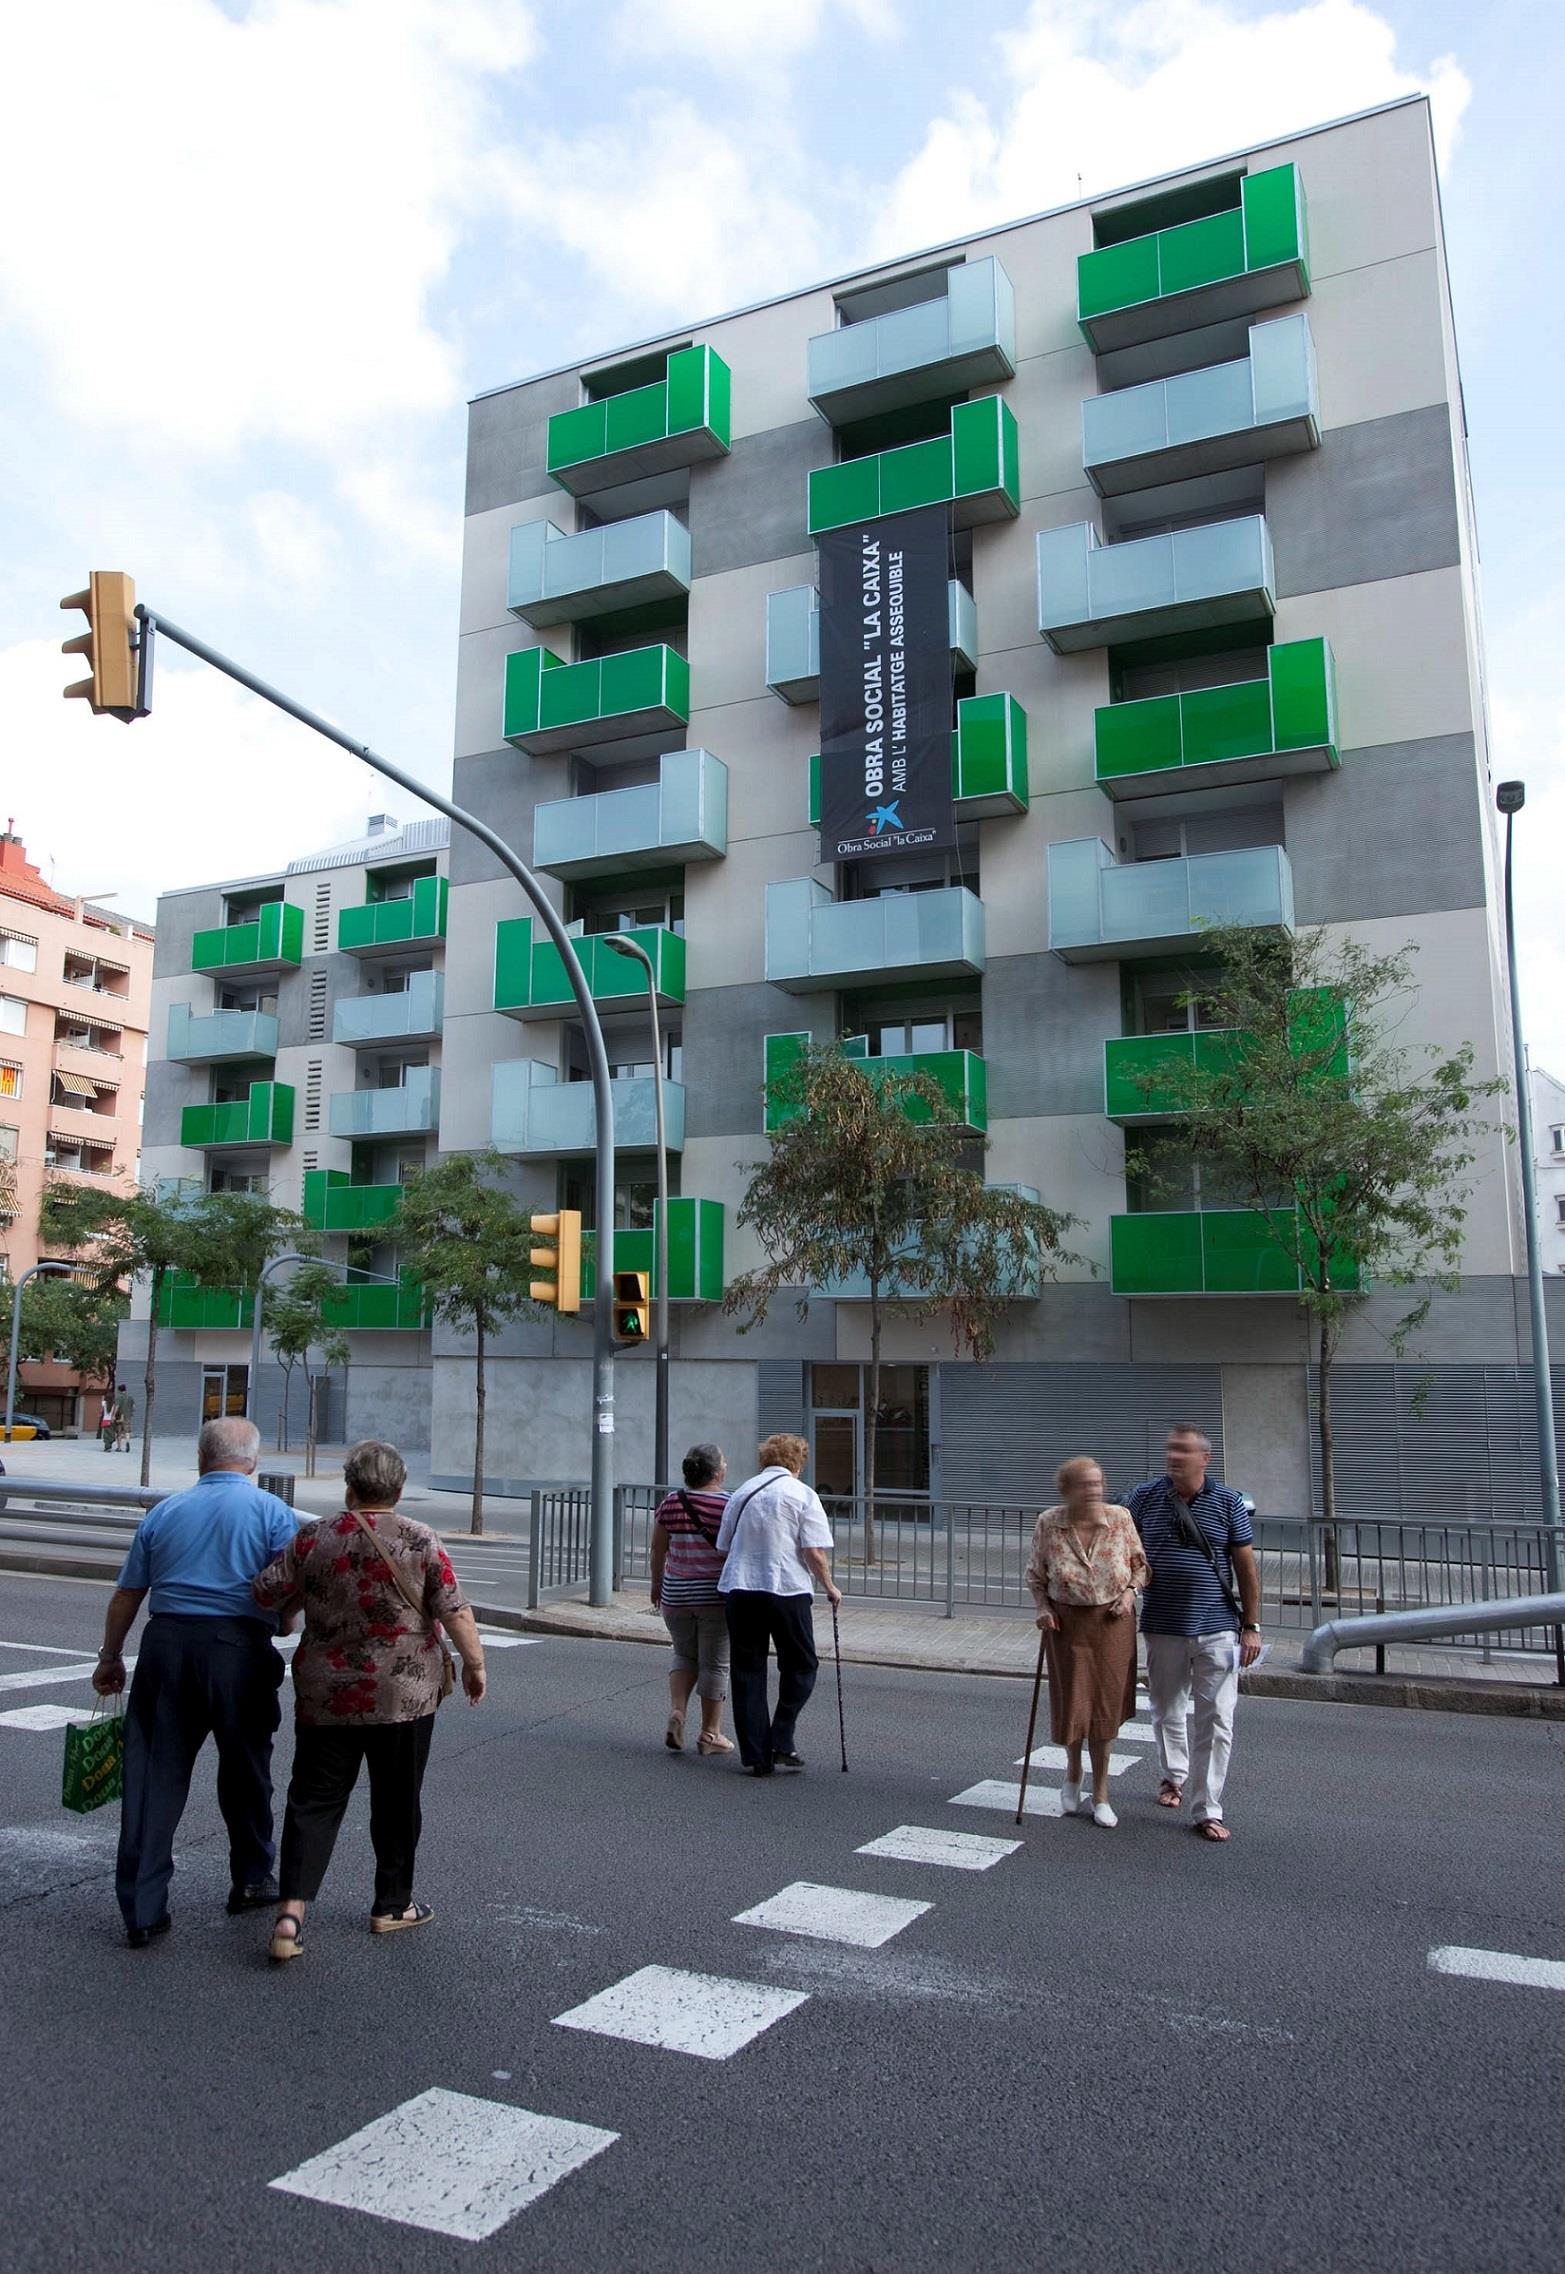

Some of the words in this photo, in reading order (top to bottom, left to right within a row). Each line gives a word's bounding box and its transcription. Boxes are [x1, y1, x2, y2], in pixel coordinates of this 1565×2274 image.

[862, 534, 881, 607] CAIXA"
[888, 551, 905, 647] ASSEQUIBLE
[864, 654, 884, 733] SOCIAL
[890, 651, 907, 741] HABITATGE
[865, 737, 884, 797] OBRA
[892, 757, 907, 793] AMB
[837, 843, 862, 854] Obra
[863, 837, 892, 850] Social
